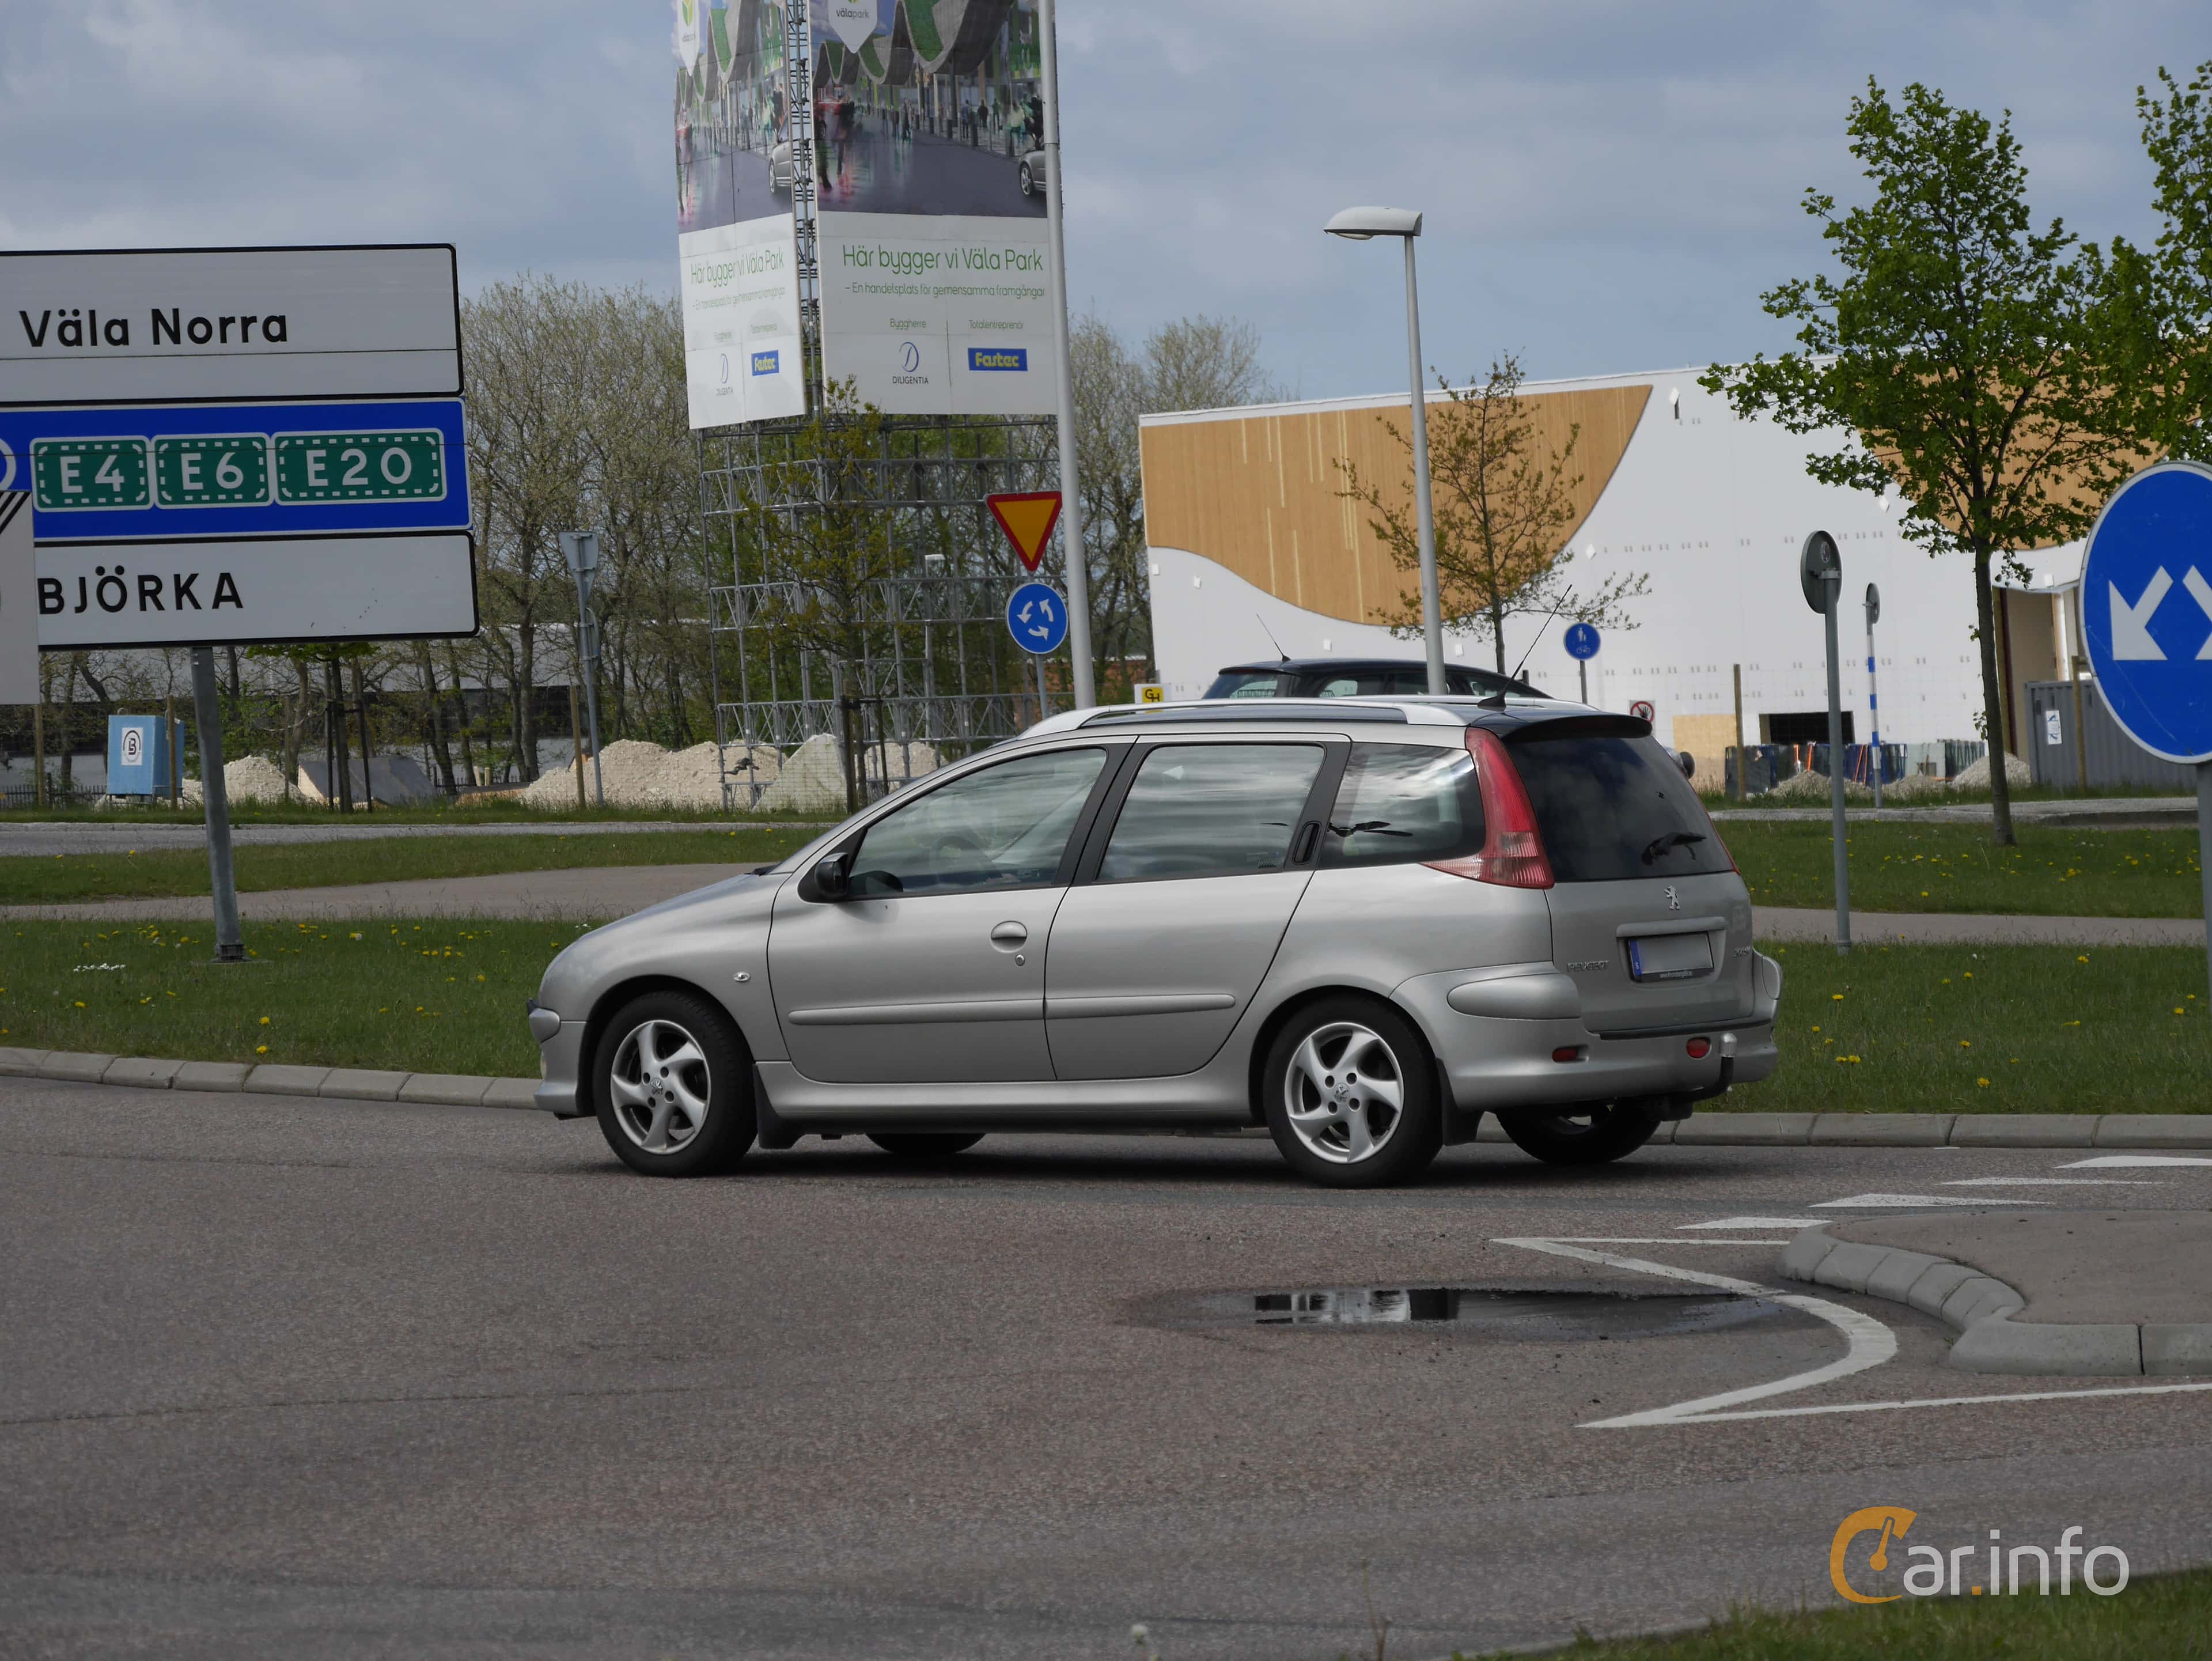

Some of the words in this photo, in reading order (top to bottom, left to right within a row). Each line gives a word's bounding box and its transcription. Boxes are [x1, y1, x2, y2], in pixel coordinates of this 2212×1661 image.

[836, 9, 869, 18] välapark
[691, 262, 704, 285] Här
[707, 260, 735, 287] bygger
[737, 254, 745, 277] vi
[764, 245, 784, 271] Park
[843, 245, 874, 267] Här
[878, 245, 940, 275] bygger
[945, 248, 959, 269] vi
[962, 248, 1001, 270] Väla
[1005, 248, 1043, 271] Park
[852, 282, 863, 293] En
[865, 282, 918, 297] handelsplats
[934, 286, 995, 298] gemensamma
[20, 309, 130, 348] Väla
[151, 308, 288, 346] Norra
[890, 318, 926, 330] Byggherre
[975, 352, 1019, 368] Fastec
[892, 376, 929, 385] DILIGENTIA
[60, 454, 124, 494] E4
[180, 451, 244, 491] E6
[306, 447, 412, 487] E20
[37, 565, 243, 615] BJÖRKA
